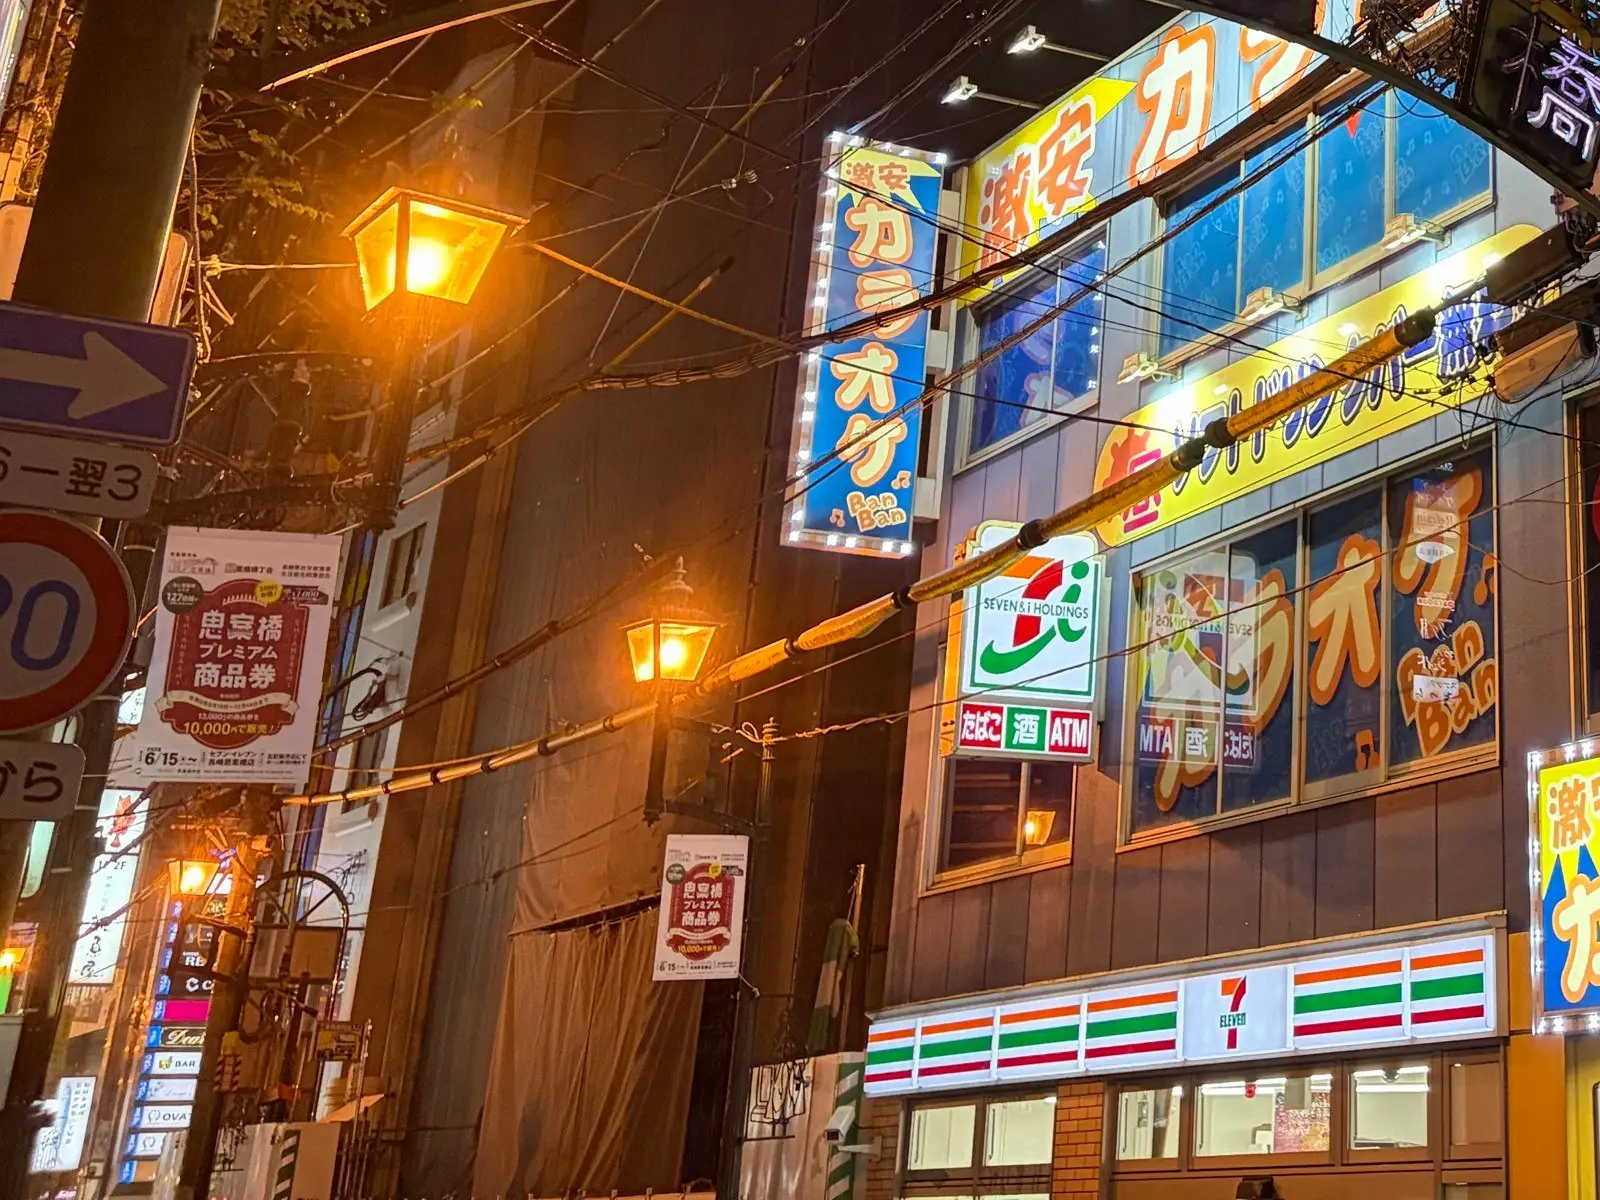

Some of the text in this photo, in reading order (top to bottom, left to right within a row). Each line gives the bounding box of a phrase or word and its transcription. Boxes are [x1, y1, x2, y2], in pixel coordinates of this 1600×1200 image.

[845, 160, 909, 192] 激安
[832, 197, 920, 487] カラオケ
[845, 490, 899, 516] Ban
[855, 504, 909, 532] Ban
[0, 574, 81, 672] 0
[198, 608, 284, 642] 思案橋
[1033, 601, 1089, 620] HOLDINGS
[199, 643, 279, 661] プレミアム
[193, 661, 277, 691] 商品券
[961, 709, 1002, 742] たばこ
[1012, 712, 1041, 745] 酒
[1050, 717, 1088, 748] ATM
[681, 911, 721, 927] 商品券
